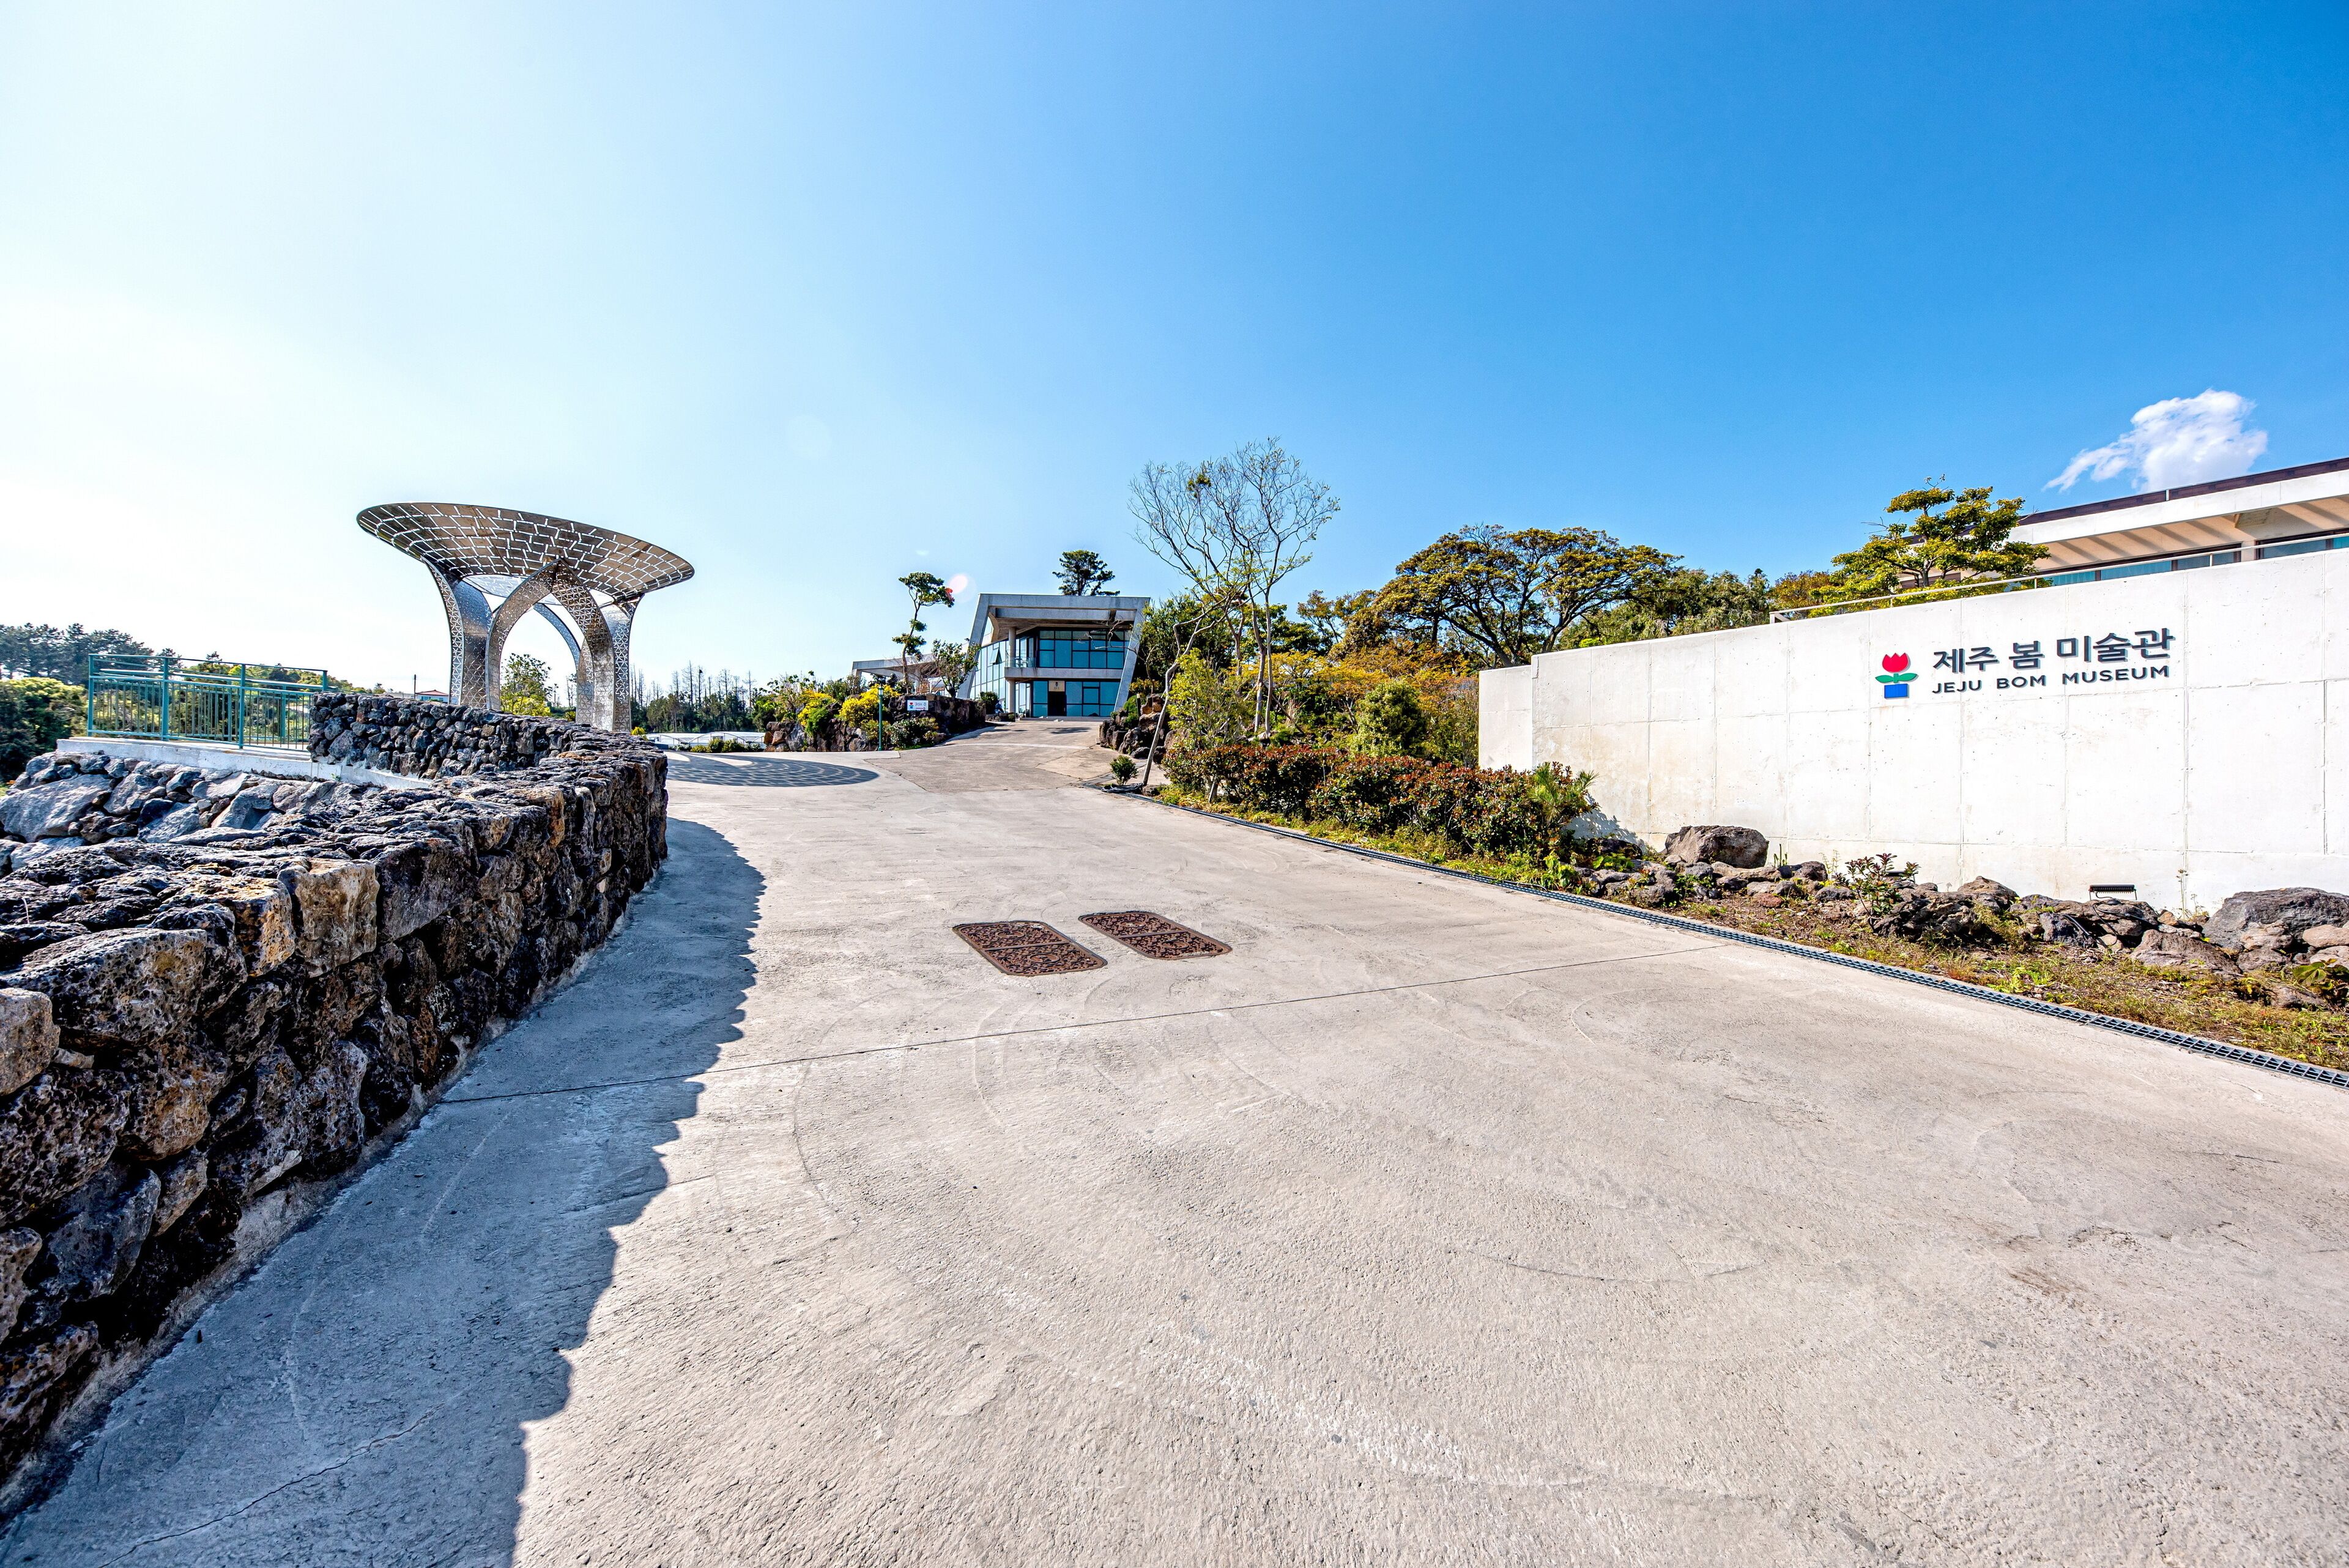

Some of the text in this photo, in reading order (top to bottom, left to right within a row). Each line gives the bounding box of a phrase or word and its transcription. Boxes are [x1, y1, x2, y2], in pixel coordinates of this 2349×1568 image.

[1933, 628, 2176, 674] 제주 봄 미술관
[1932, 665, 2169, 694] JEJU BOM MUSEUM
